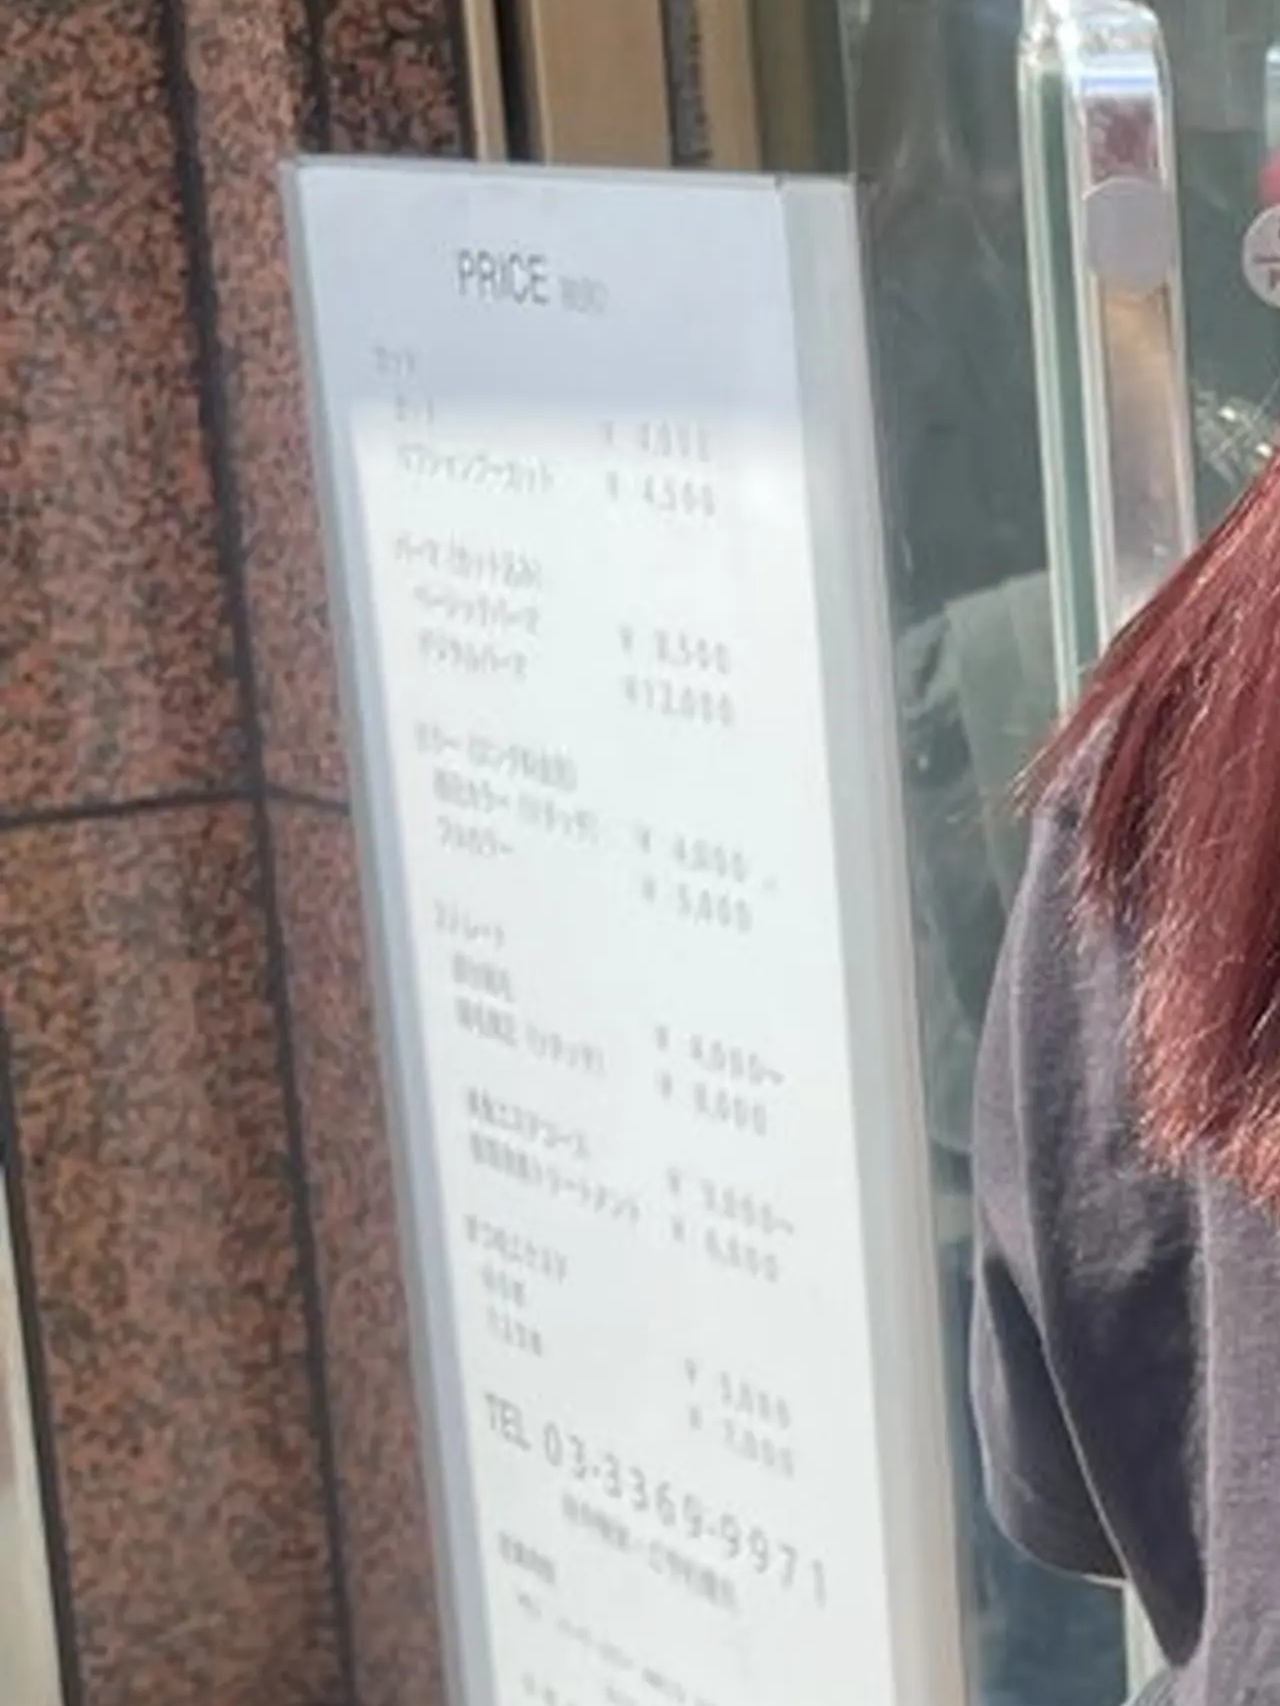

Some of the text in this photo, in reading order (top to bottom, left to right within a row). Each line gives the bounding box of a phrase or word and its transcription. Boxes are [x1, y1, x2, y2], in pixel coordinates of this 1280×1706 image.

[457, 248, 550, 305] PRICE
[484, 1391, 531, 1452] TEL
[543, 1421, 827, 1610] 03-3369-9971
